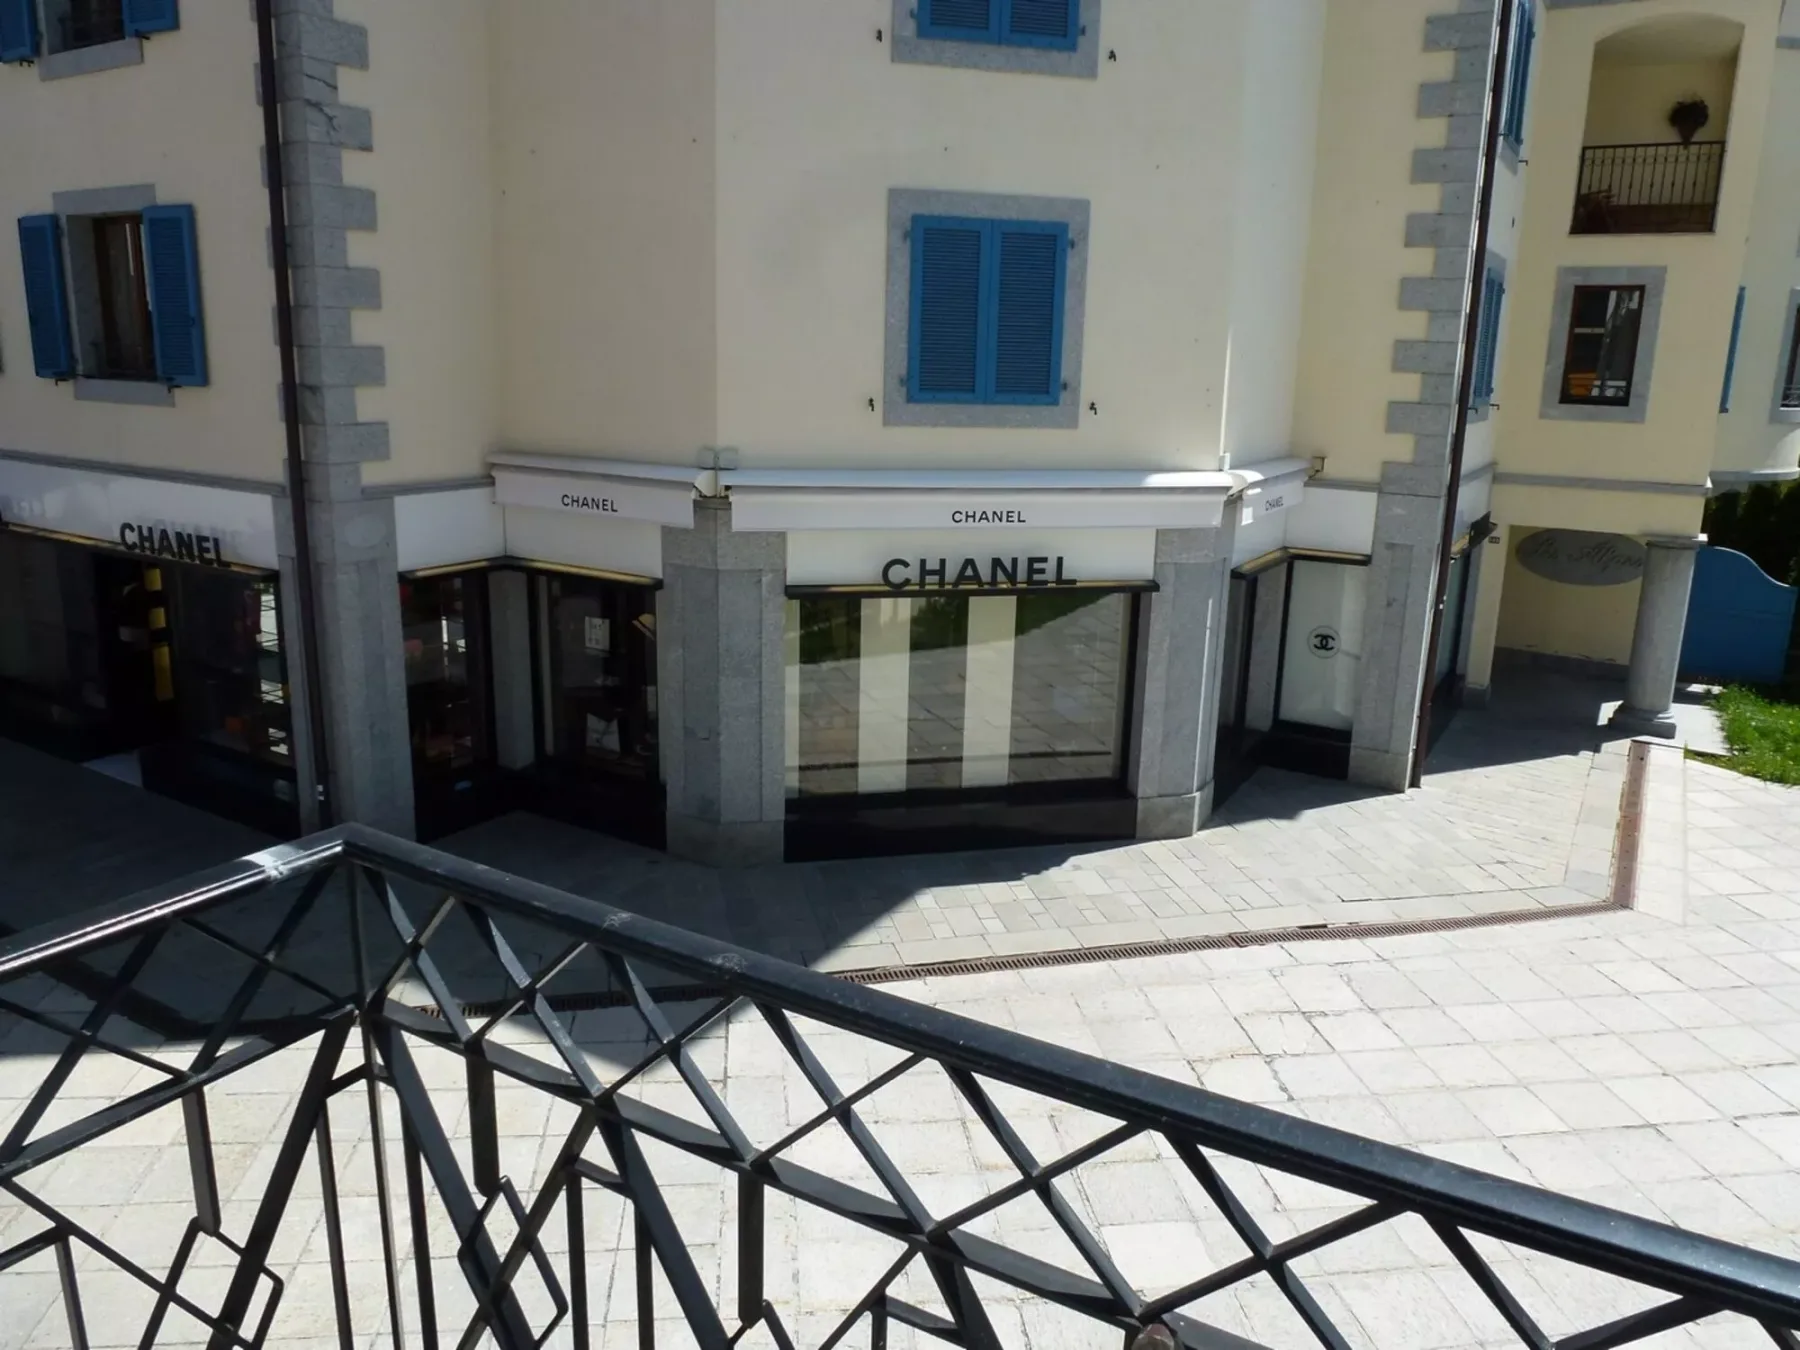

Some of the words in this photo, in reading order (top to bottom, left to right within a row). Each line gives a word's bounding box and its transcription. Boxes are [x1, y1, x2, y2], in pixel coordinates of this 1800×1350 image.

[561, 493, 619, 513] CHANEL
[952, 510, 1026, 524] CHANEL
[119, 522, 232, 567] CHANEL
[881, 556, 1078, 590] CHANEL
